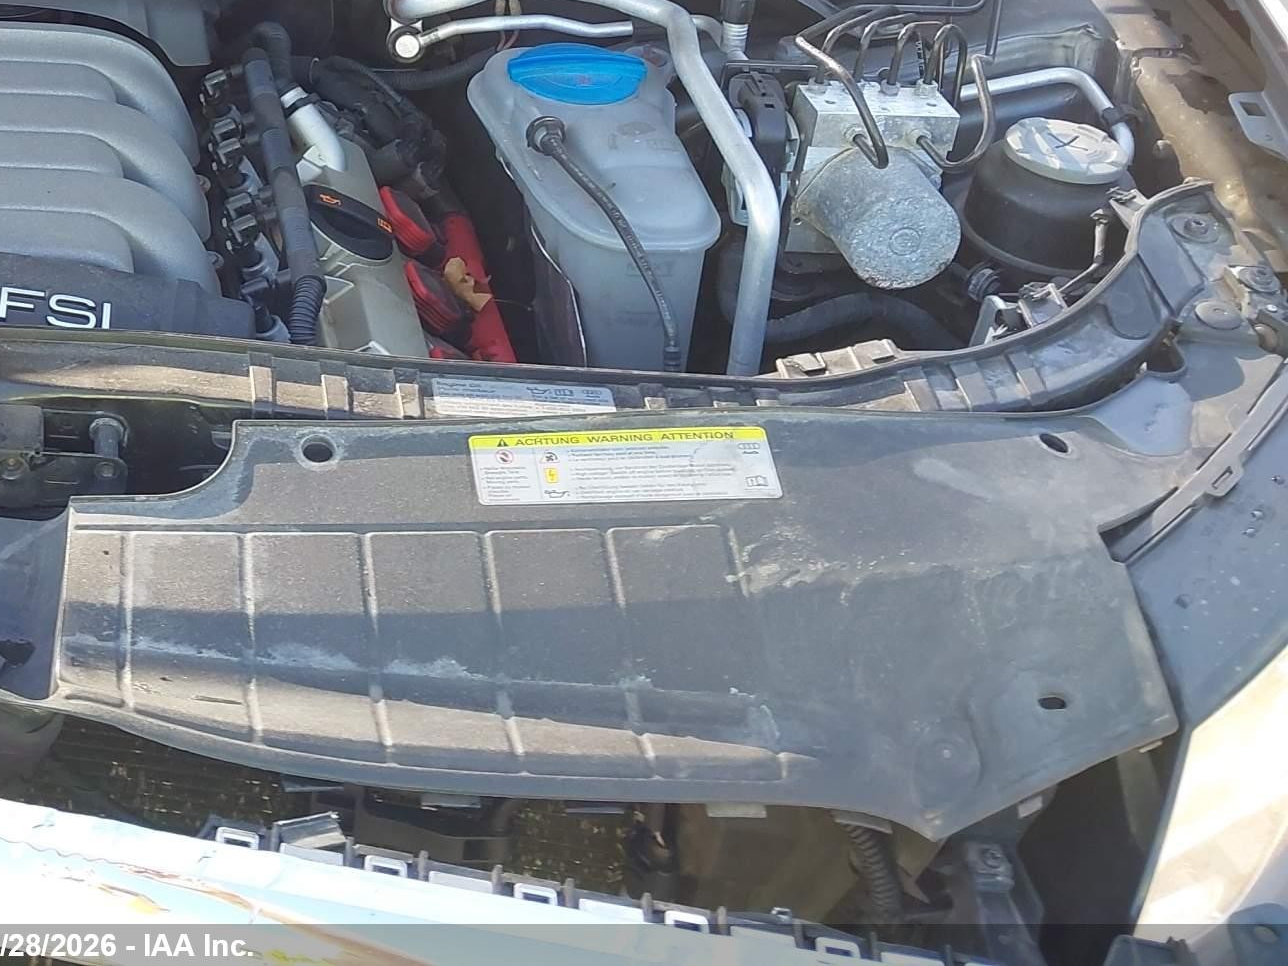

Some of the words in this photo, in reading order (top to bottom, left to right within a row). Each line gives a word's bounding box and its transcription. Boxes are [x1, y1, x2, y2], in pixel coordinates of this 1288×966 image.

[515, 436, 580, 446] ACHTUNG
[587, 433, 653, 443] WARNING
[660, 431, 734, 441] ATTENTION
